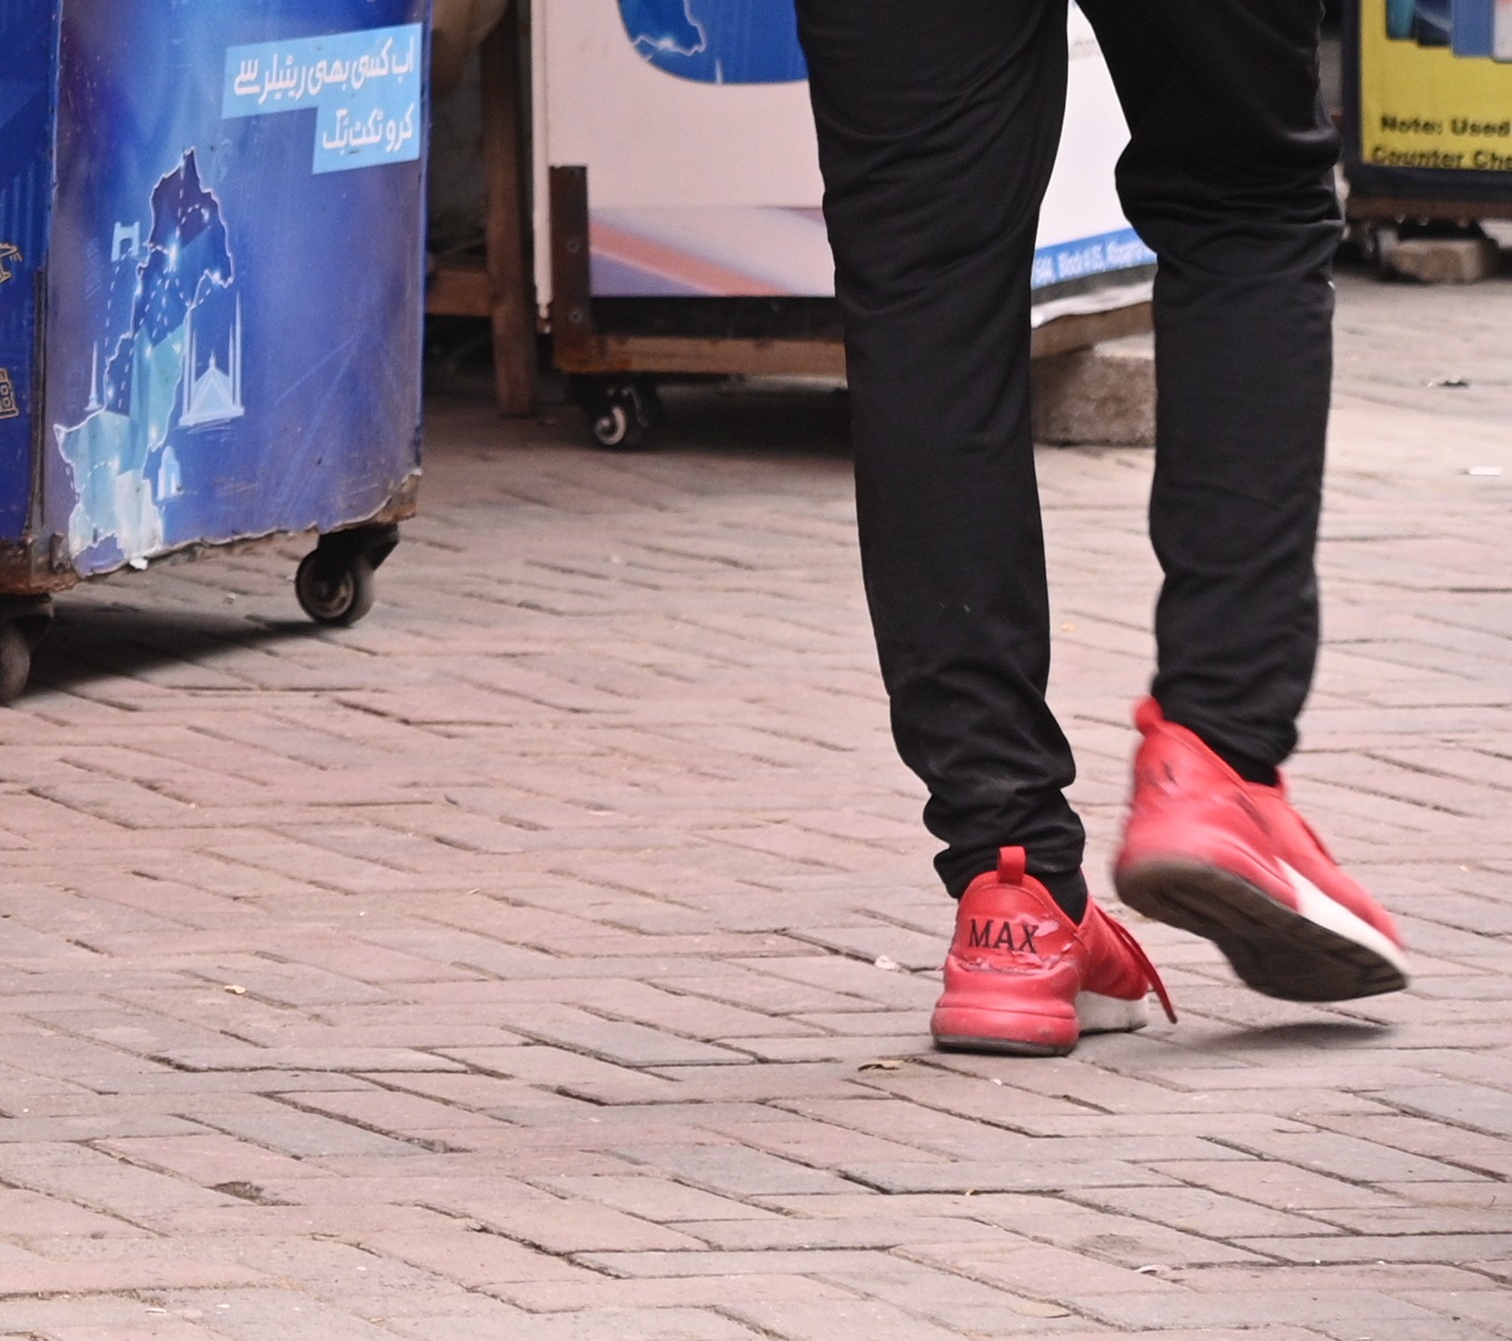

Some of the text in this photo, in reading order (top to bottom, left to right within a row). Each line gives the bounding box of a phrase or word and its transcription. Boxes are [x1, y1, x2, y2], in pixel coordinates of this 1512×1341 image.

[233, 56, 260, 96] سے
[353, 38, 393, 89] کسی
[391, 37, 415, 83] اب
[1380, 114, 1509, 138] Note: Used
[1371, 147, 1463, 171] Counter
[967, 917, 1041, 956] MAX
